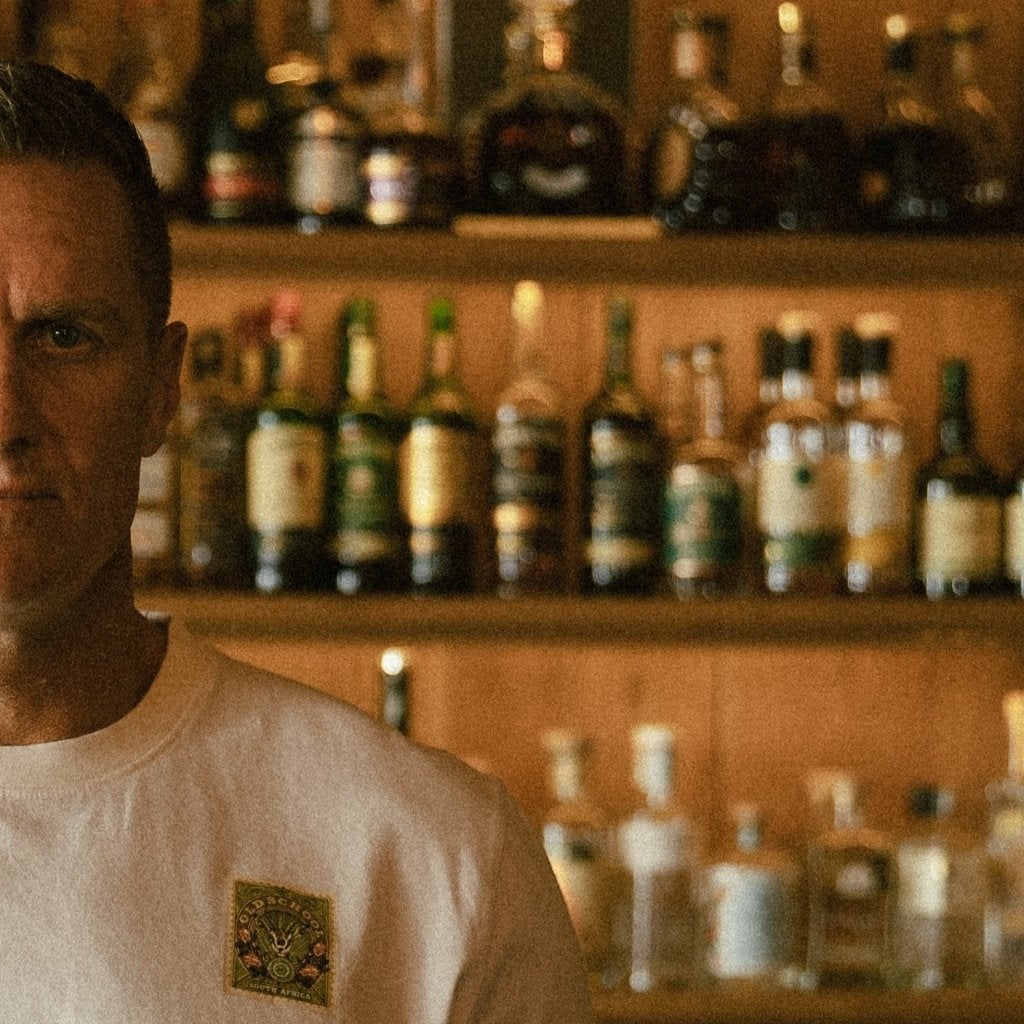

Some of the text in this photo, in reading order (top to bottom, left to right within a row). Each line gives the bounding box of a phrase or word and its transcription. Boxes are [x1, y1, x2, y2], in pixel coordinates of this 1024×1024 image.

[239, 896, 325, 938] OLD SCHOOL
[247, 982, 312, 1000] SOUTH AFRICA
